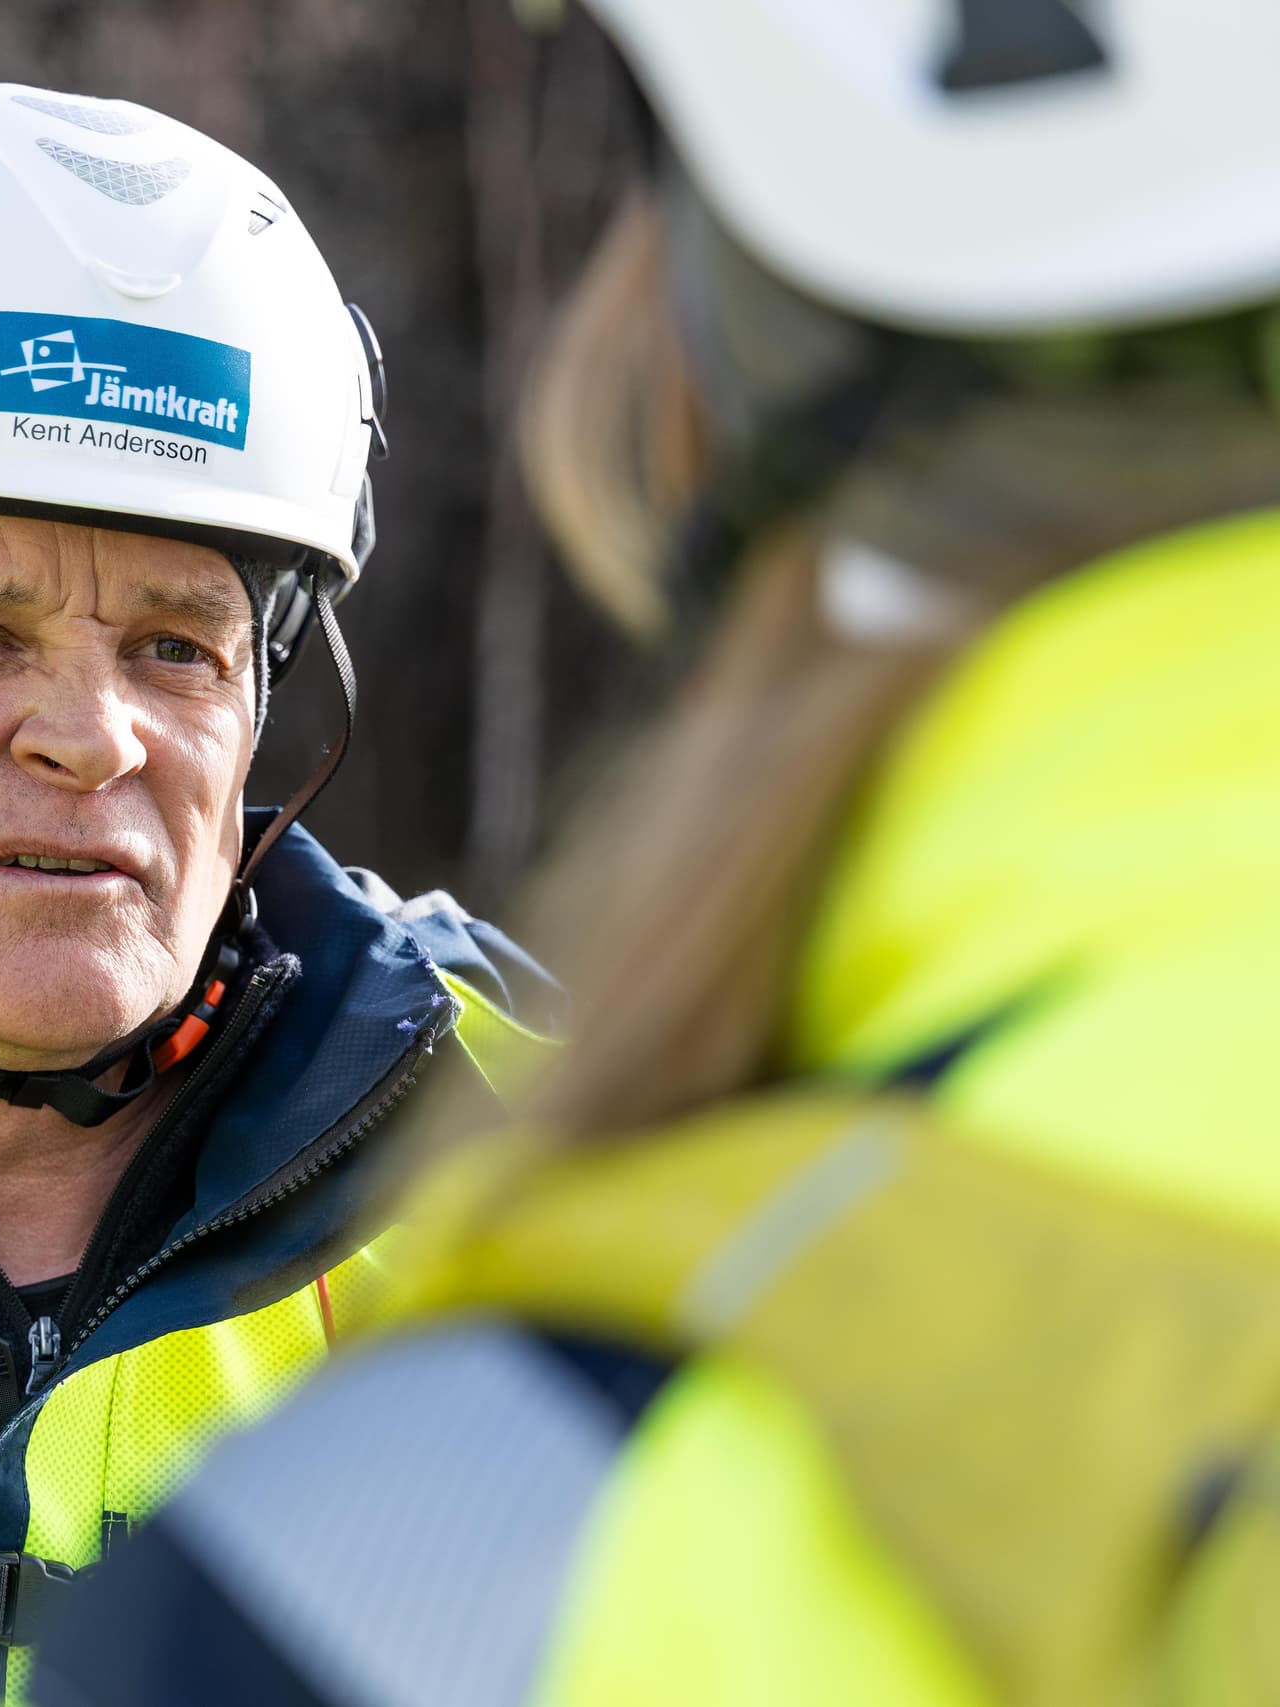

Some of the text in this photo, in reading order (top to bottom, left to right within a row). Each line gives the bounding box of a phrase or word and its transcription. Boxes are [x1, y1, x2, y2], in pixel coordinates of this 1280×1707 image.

[84, 372, 239, 433] Jämtkraft
[12, 415, 208, 464] Kent Andersson
